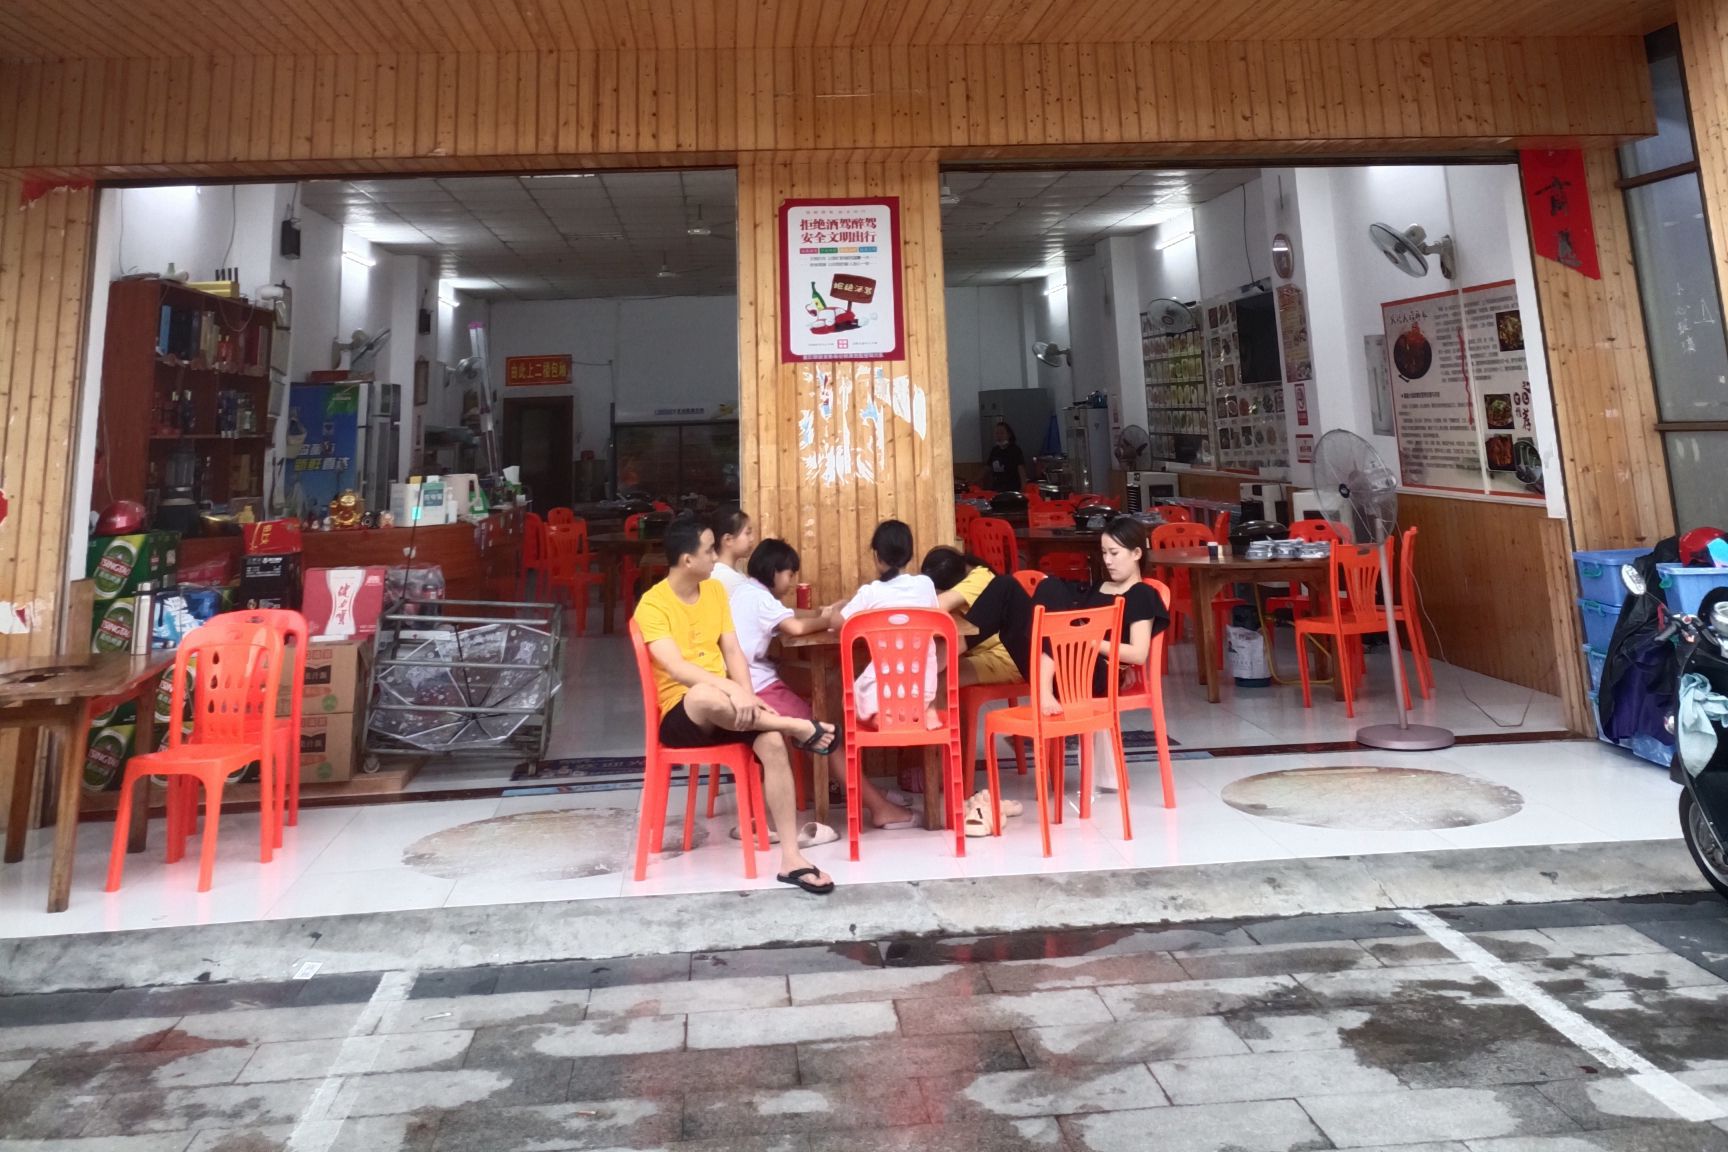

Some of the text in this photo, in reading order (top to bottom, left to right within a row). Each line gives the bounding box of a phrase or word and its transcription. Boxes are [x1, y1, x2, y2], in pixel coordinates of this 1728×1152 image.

[800, 217, 877, 230] 拒绝酒驾醉驾
[801, 231, 877, 244] 安全文明出行
